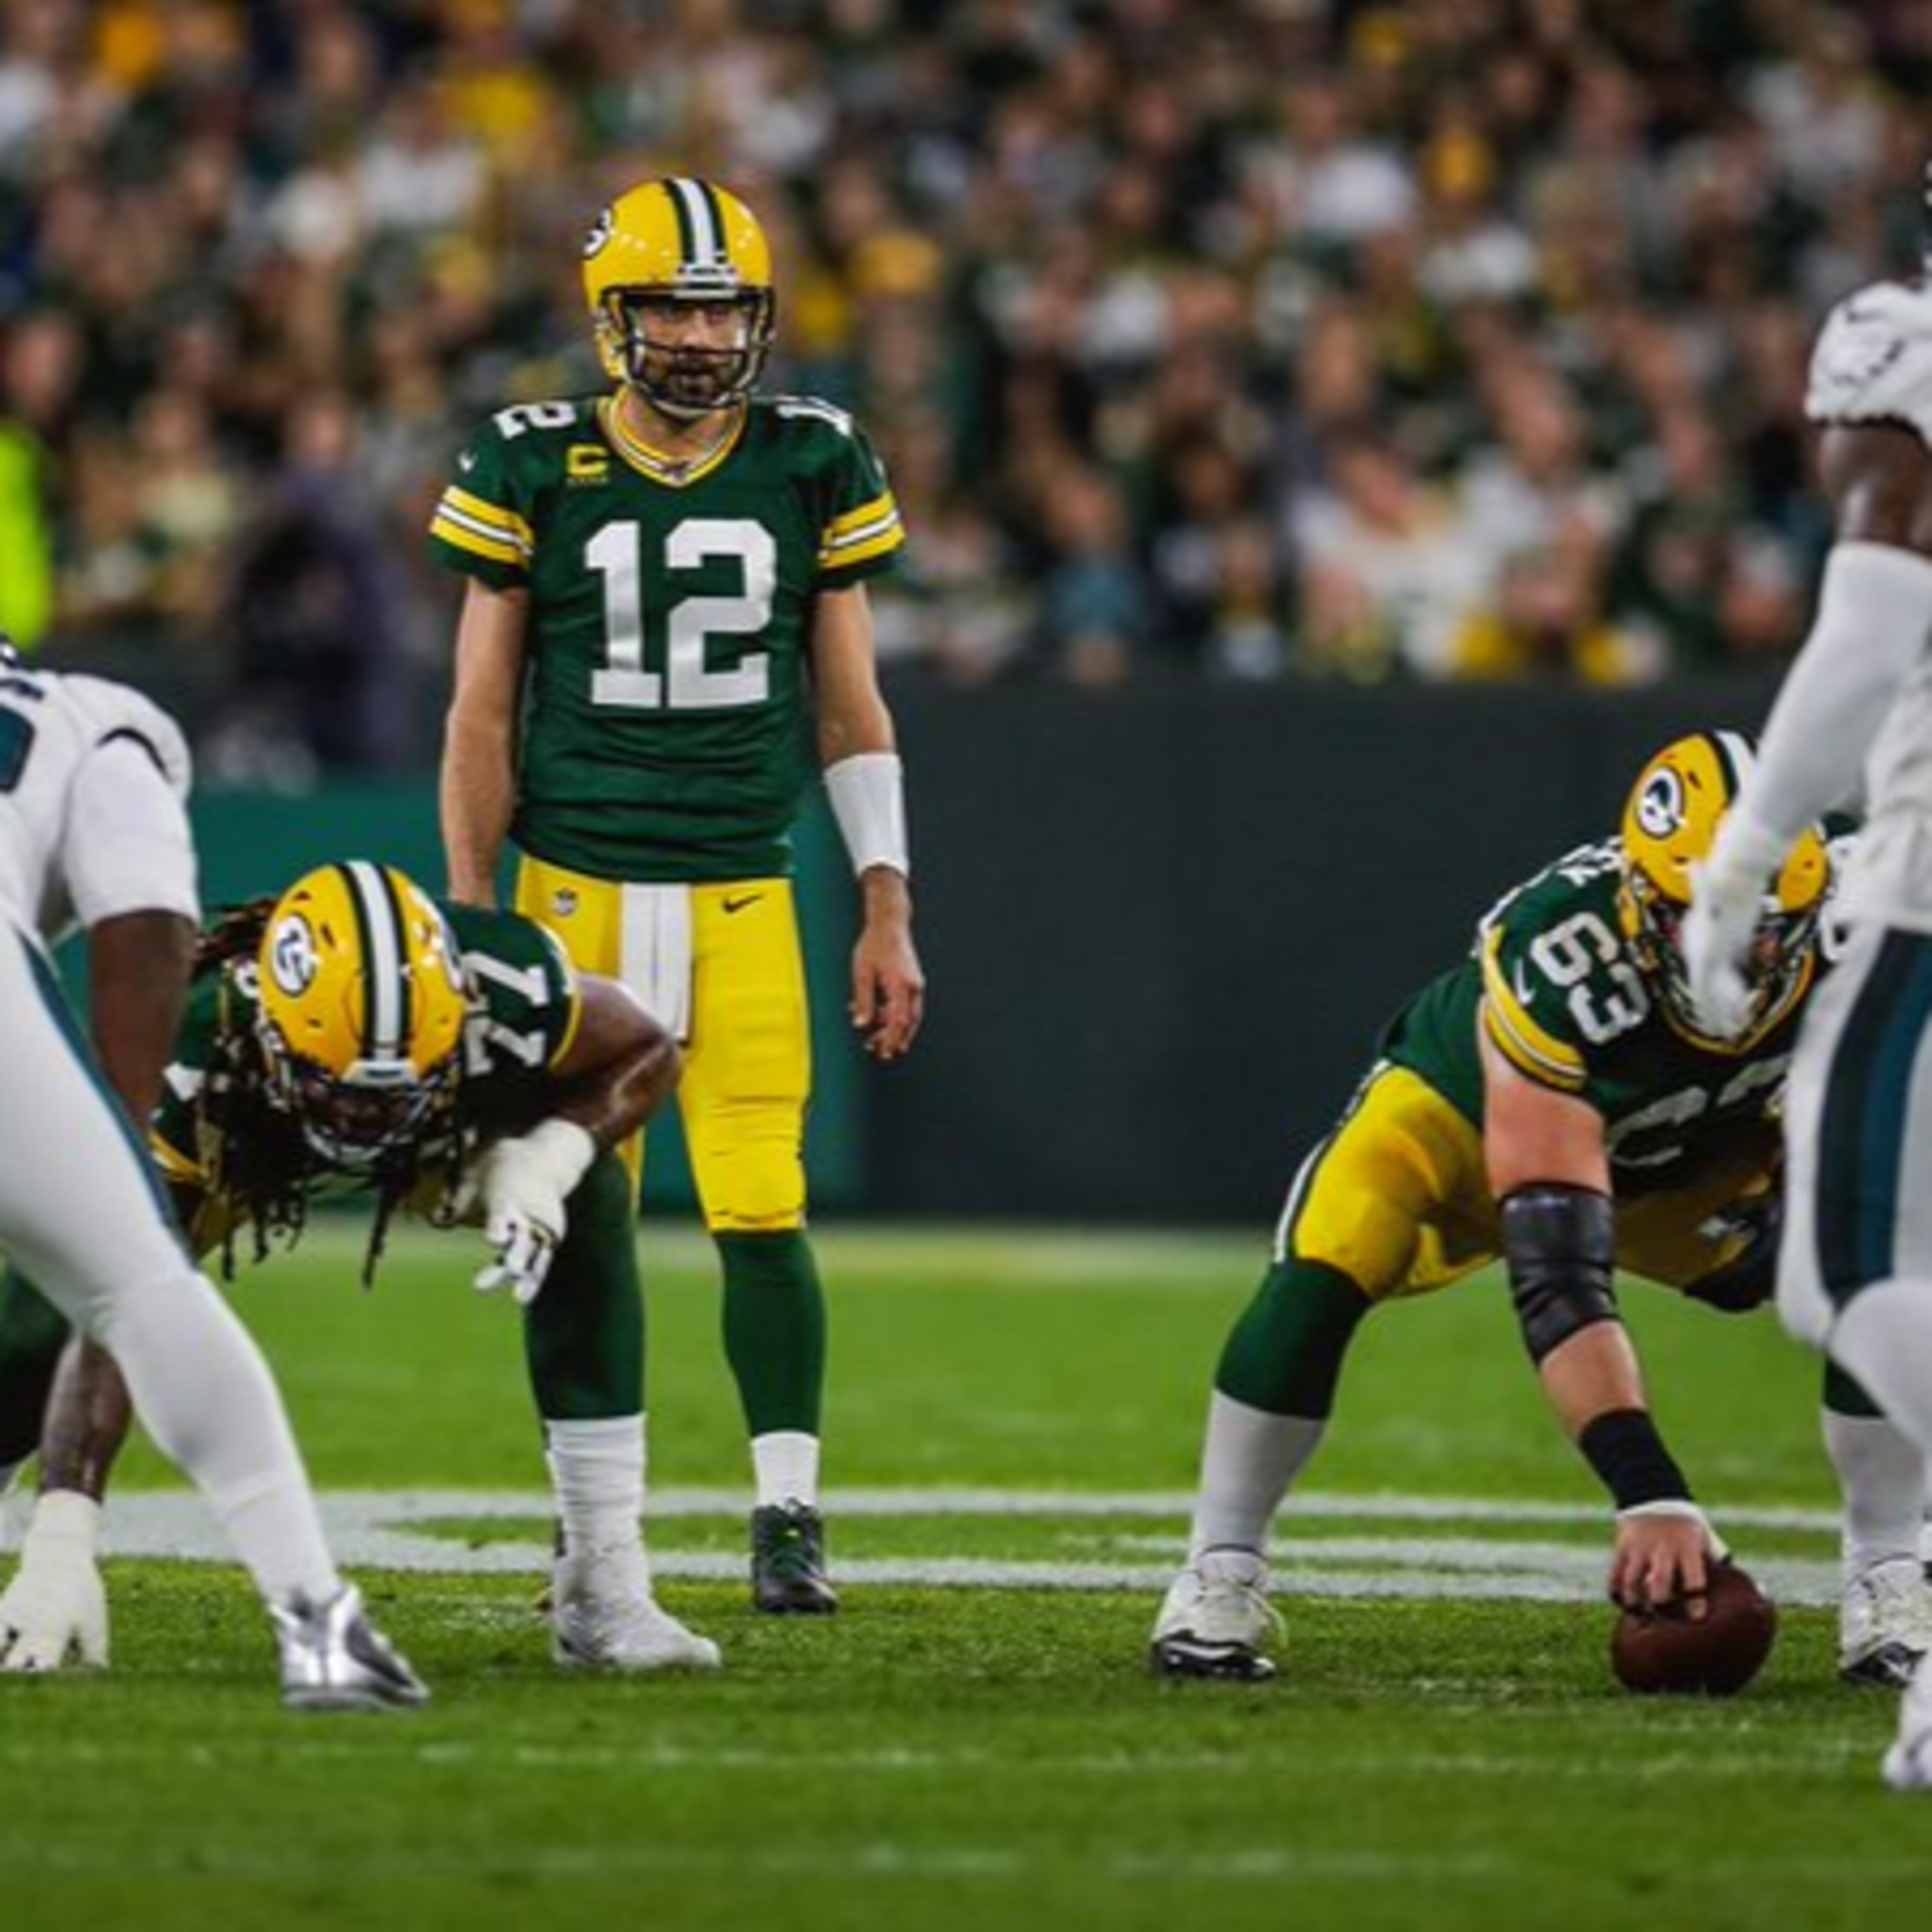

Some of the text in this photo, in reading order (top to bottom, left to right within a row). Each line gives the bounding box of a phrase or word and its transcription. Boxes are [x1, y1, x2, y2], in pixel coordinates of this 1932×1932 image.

[567, 444, 609, 477] C
[583, 518, 777, 709] 12
[460, 951, 549, 1077] 77
[1530, 911, 1649, 1045] 63
